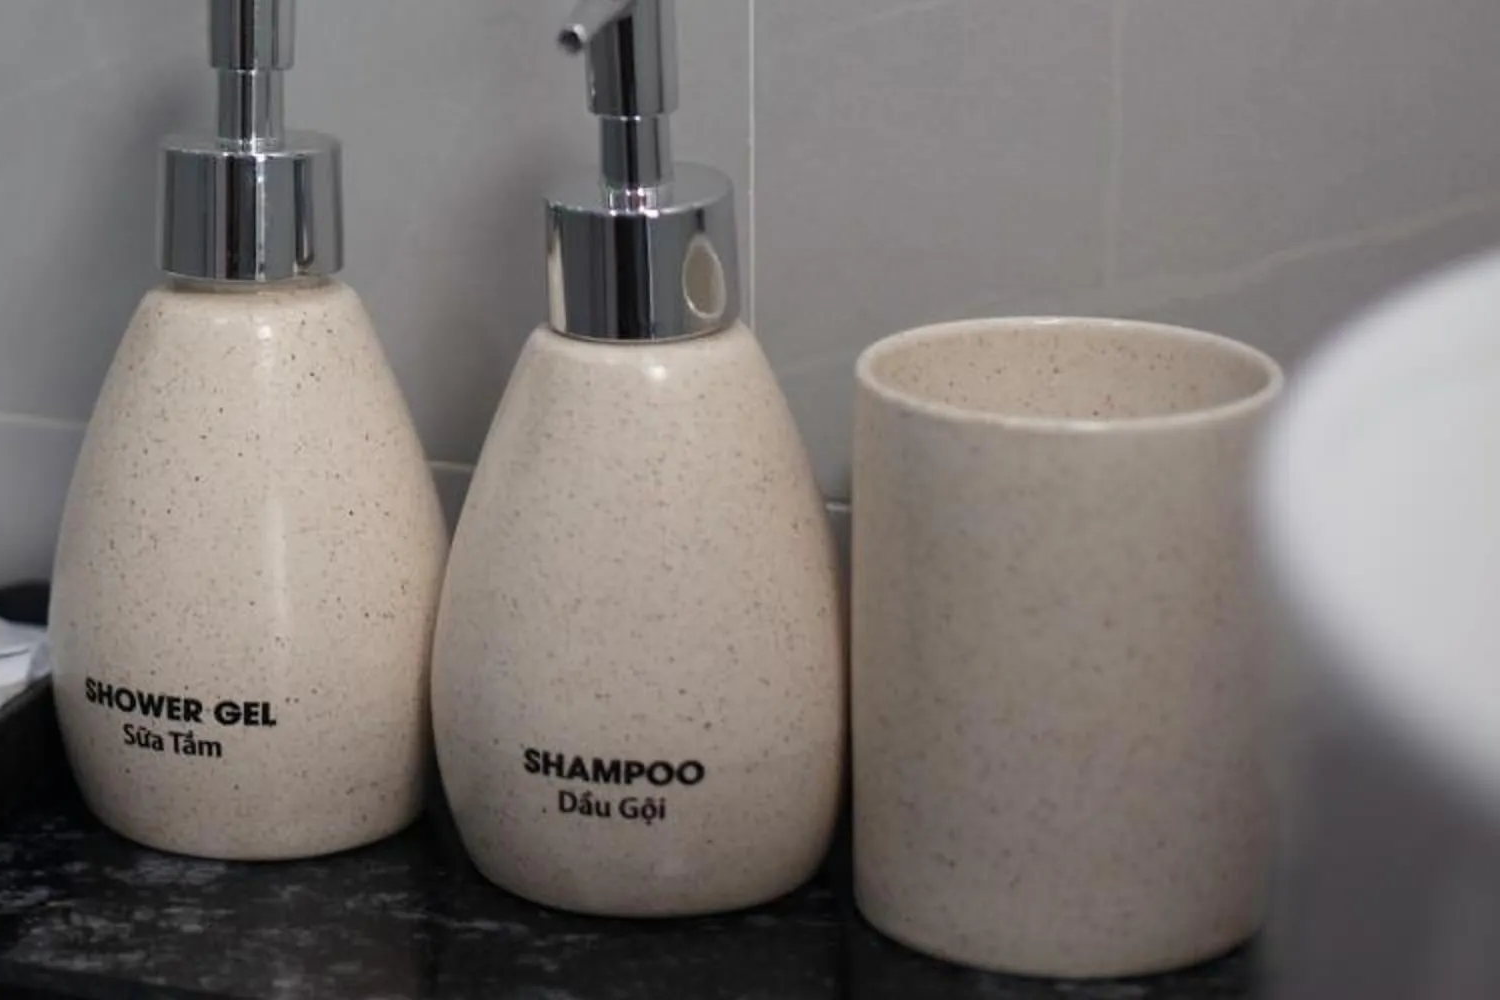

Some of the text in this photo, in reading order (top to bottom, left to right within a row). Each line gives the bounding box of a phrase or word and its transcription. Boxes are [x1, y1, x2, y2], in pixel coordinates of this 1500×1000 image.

[85, 677, 277, 726] SHOWER GEL
[523, 747, 705, 786] SHAMPOO
